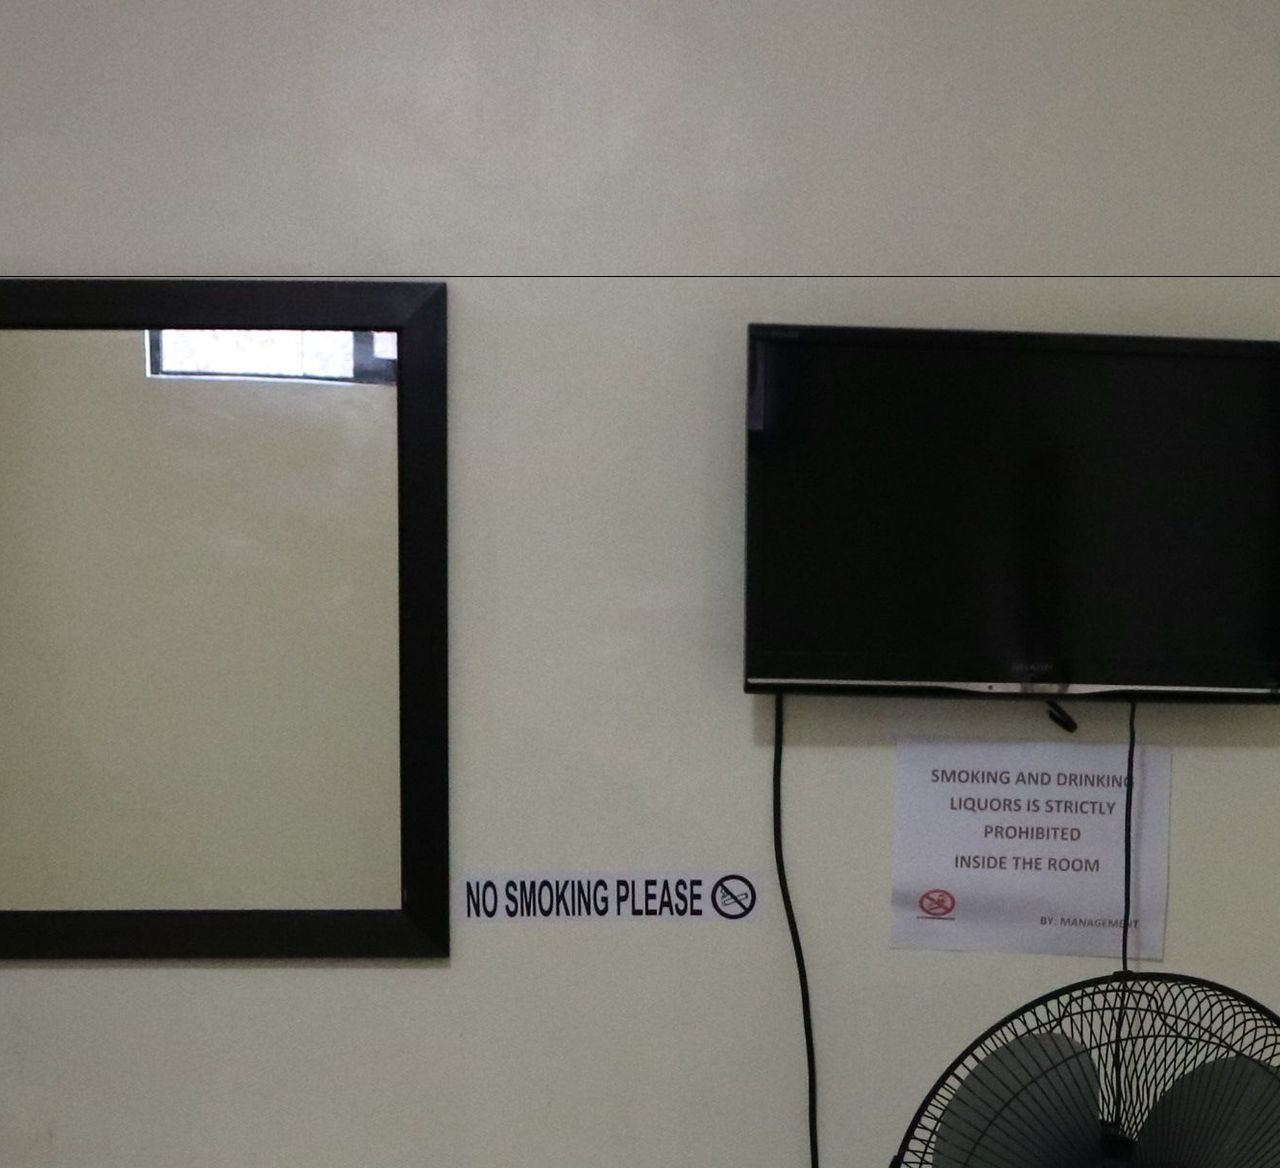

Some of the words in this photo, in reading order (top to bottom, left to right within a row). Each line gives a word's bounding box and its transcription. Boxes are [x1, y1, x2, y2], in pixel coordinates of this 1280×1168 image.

[930, 769, 1010, 785] SMOKING
[1016, 772, 1051, 786] AND
[950, 797, 1022, 813] LIQUORS
[1026, 799, 1040, 813] IS
[1045, 800, 1116, 815] STRICTLY
[983, 825, 1082, 842] PROHIBITED
[954, 855, 1007, 870] INSIDE
[1012, 857, 1042, 871] THE
[1047, 858, 1100, 872] ROOM
[466, 880, 498, 918] NO
[505, 879, 609, 918] SMOKING
[616, 879, 703, 916] PLEASE
